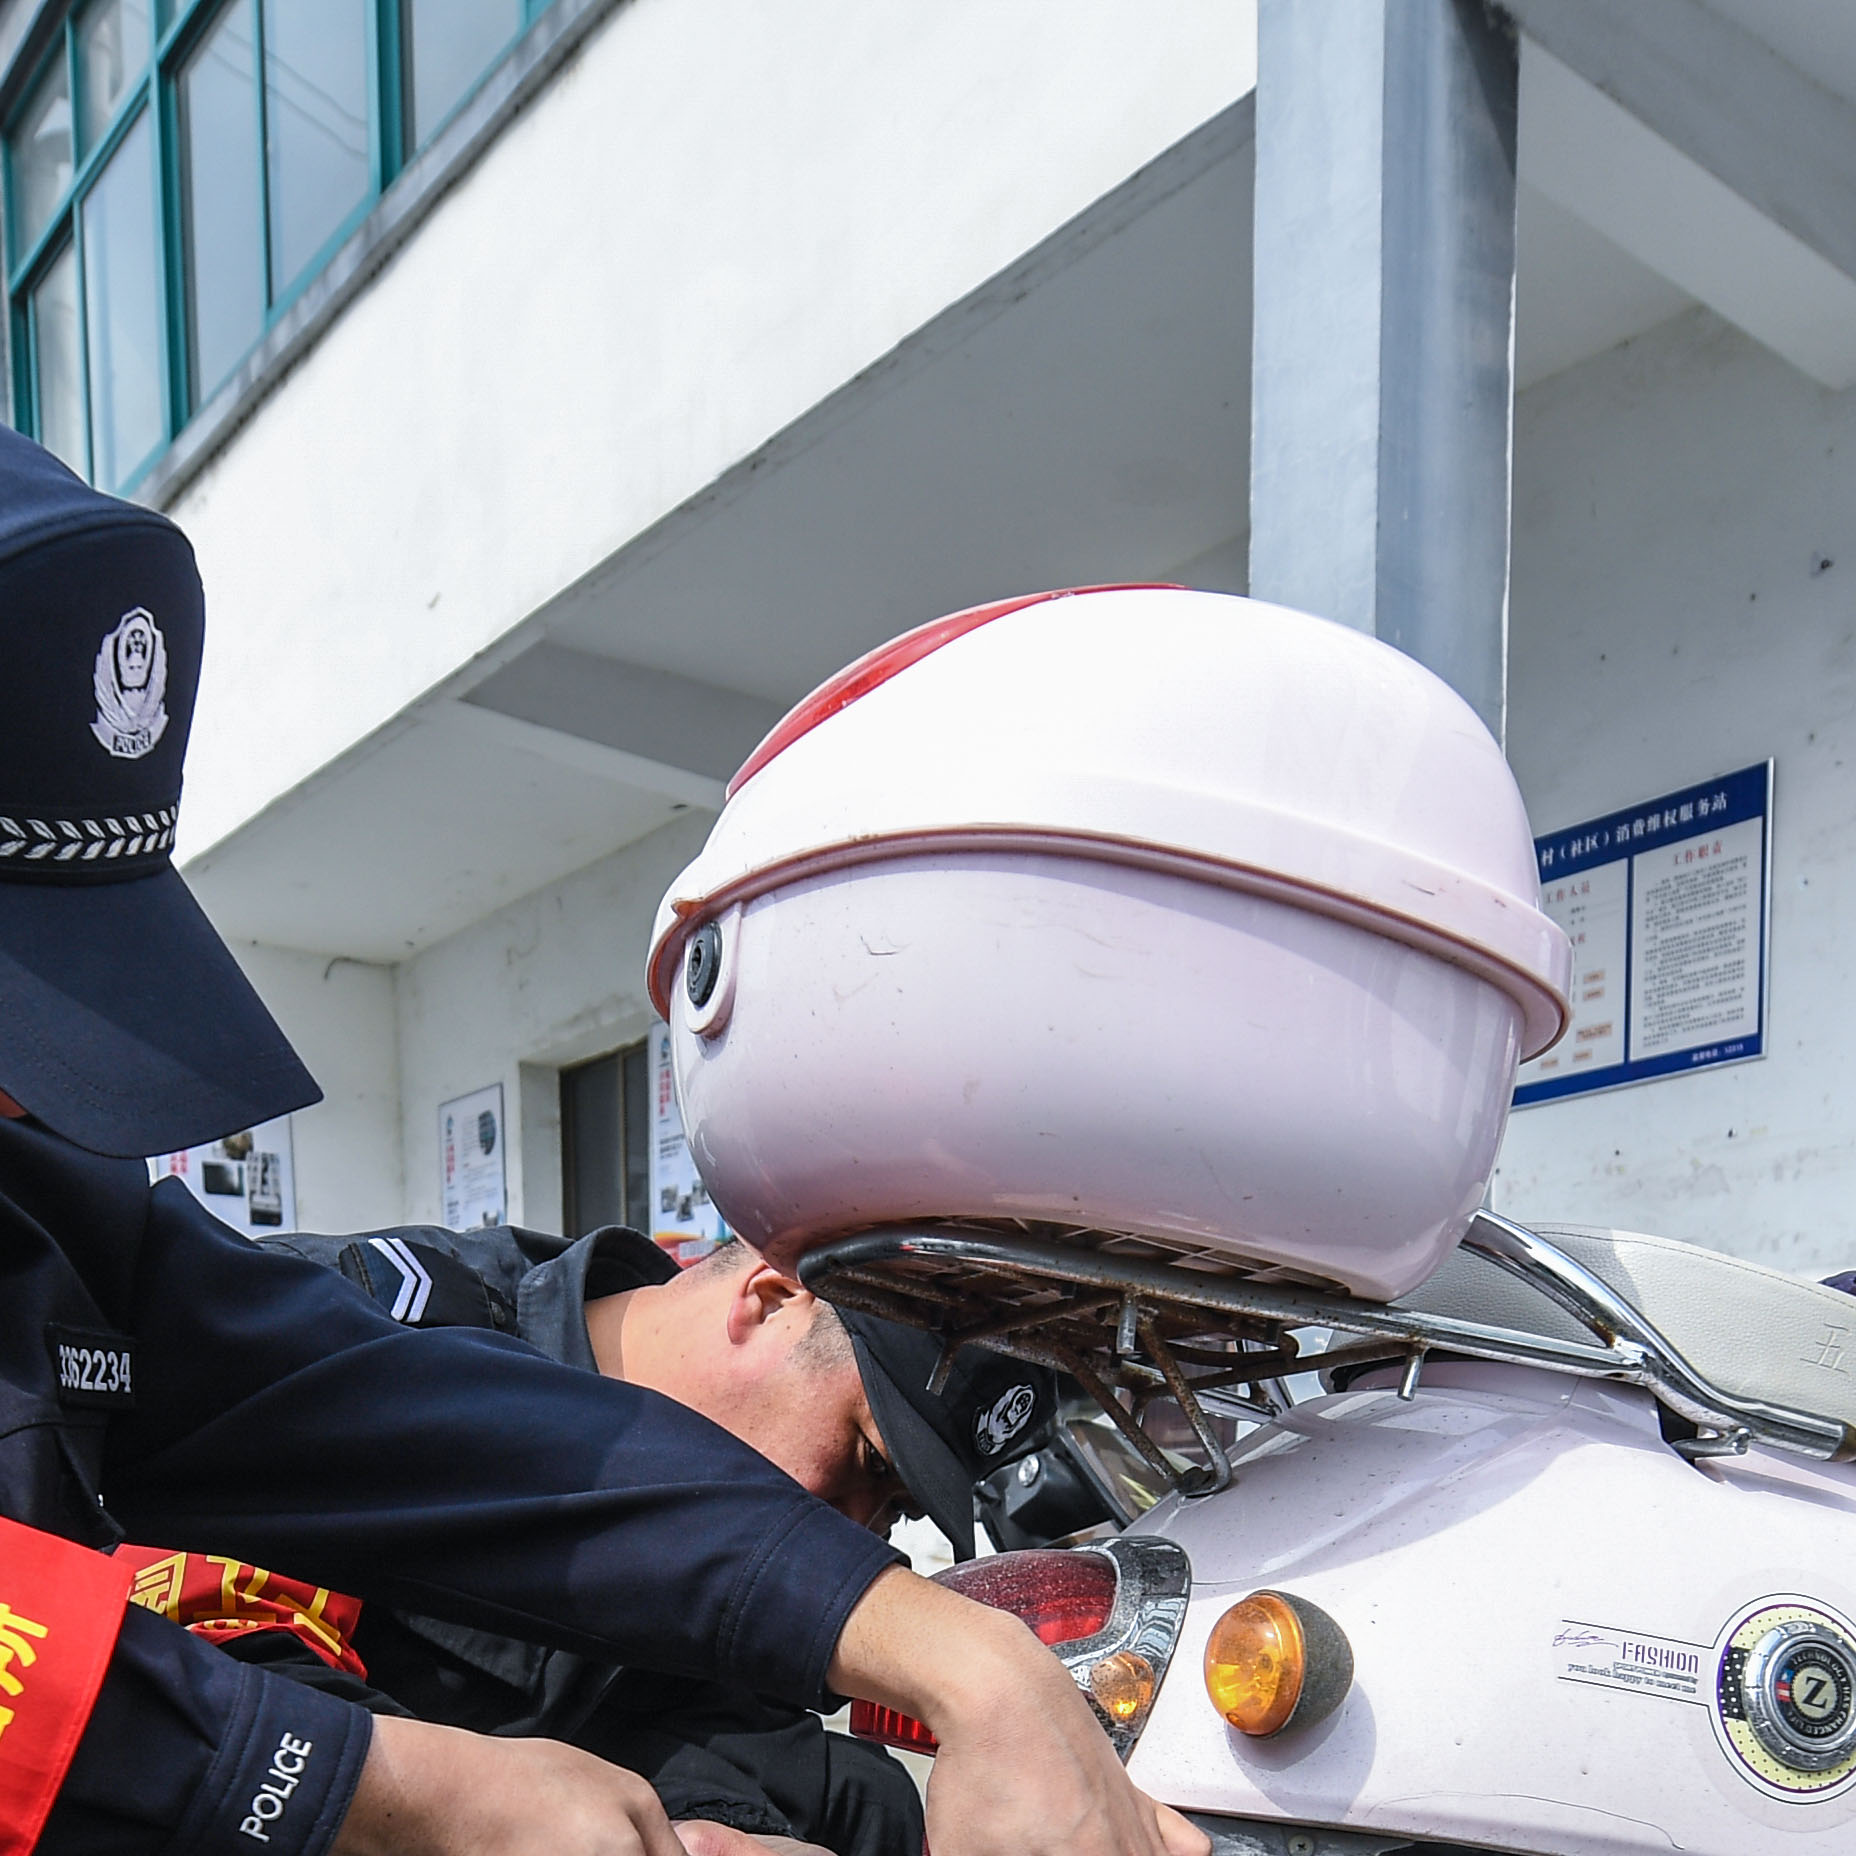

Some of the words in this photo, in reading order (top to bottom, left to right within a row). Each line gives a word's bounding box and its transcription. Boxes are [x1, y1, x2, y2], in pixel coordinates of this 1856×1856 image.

[1622, 1641, 1699, 1673] FASHION
[1801, 1676, 1828, 1709] Z
[239, 1731, 313, 1842] POLICE
